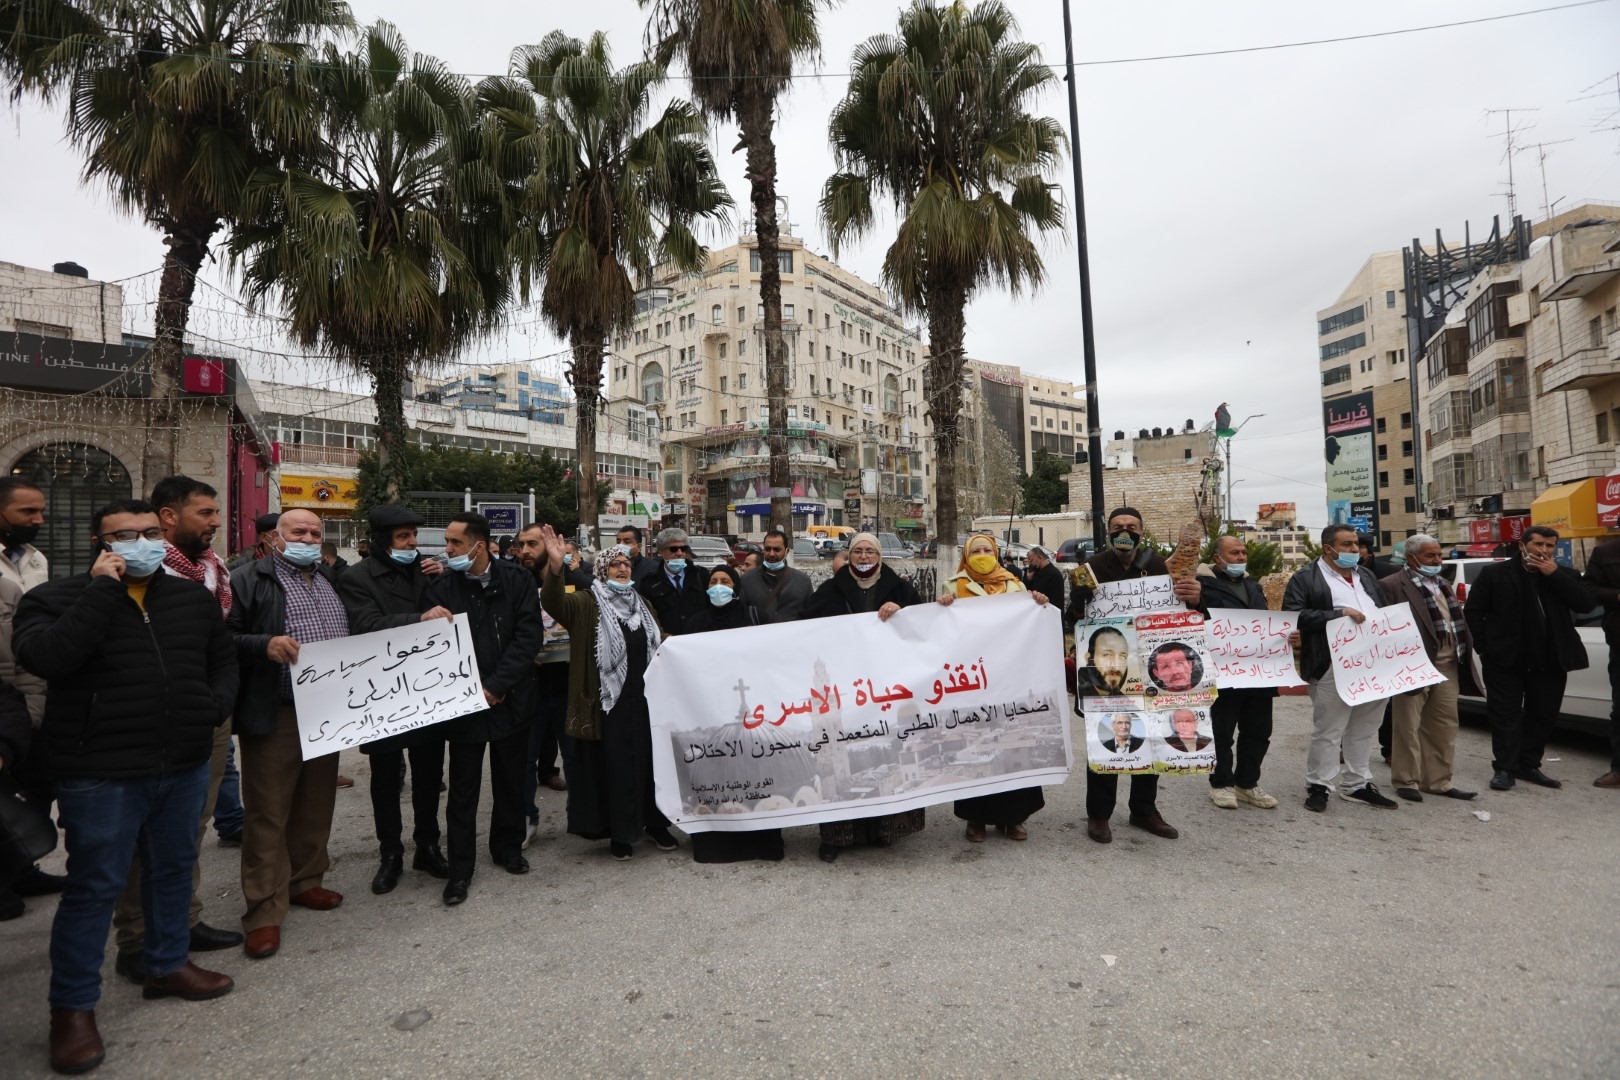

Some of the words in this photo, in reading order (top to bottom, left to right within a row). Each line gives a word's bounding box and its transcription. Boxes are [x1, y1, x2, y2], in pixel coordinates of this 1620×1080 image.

[833, 303, 849, 321] City
[1213, 618, 1248, 639] دولية
[1252, 616, 1292, 640] حماية
[382, 623, 461, 672] اوقفوا
[296, 654, 378, 686] سياسة
[412, 655, 473, 692] الموت
[924, 656, 989, 705] أنقذو
[741, 683, 842, 730] الاسرى
[852, 677, 914, 712] حياة
[944, 703, 998, 730] الاهمال
[1002, 699, 1050, 722] ضحايا
[836, 719, 890, 743] المتعمد
[896, 711, 939, 742] الطبي
[682, 738, 744, 764] الاحتلال
[750, 739, 801, 760] سجون
[806, 727, 830, 755] في
[726, 779, 752, 792] الوطنية
[754, 777, 774, 789] القوى
[697, 796, 720, 806] والبيرة
[731, 794, 744, 805] رام
[744, 791, 772, 801] محافظة
